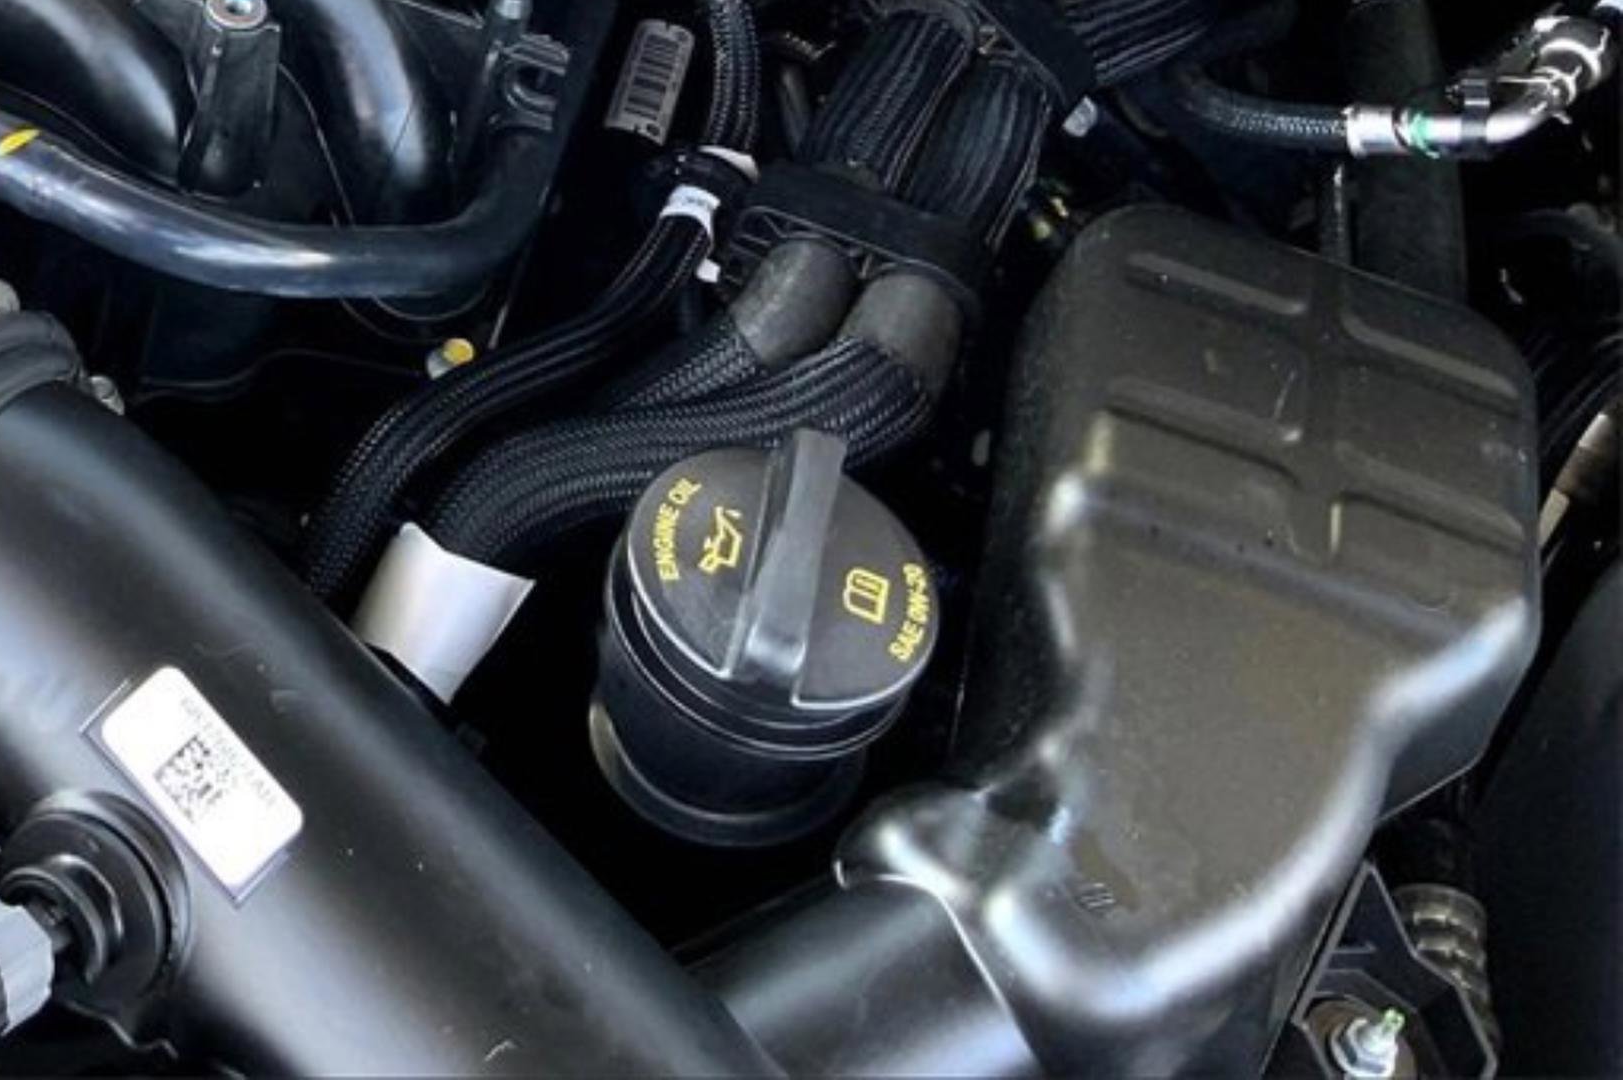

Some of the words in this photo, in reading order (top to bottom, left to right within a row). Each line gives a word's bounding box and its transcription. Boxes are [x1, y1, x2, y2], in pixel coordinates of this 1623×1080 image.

[653, 503, 680, 581] ENGINE
[668, 477, 703, 505] OIL
[888, 620, 925, 661] SAE
